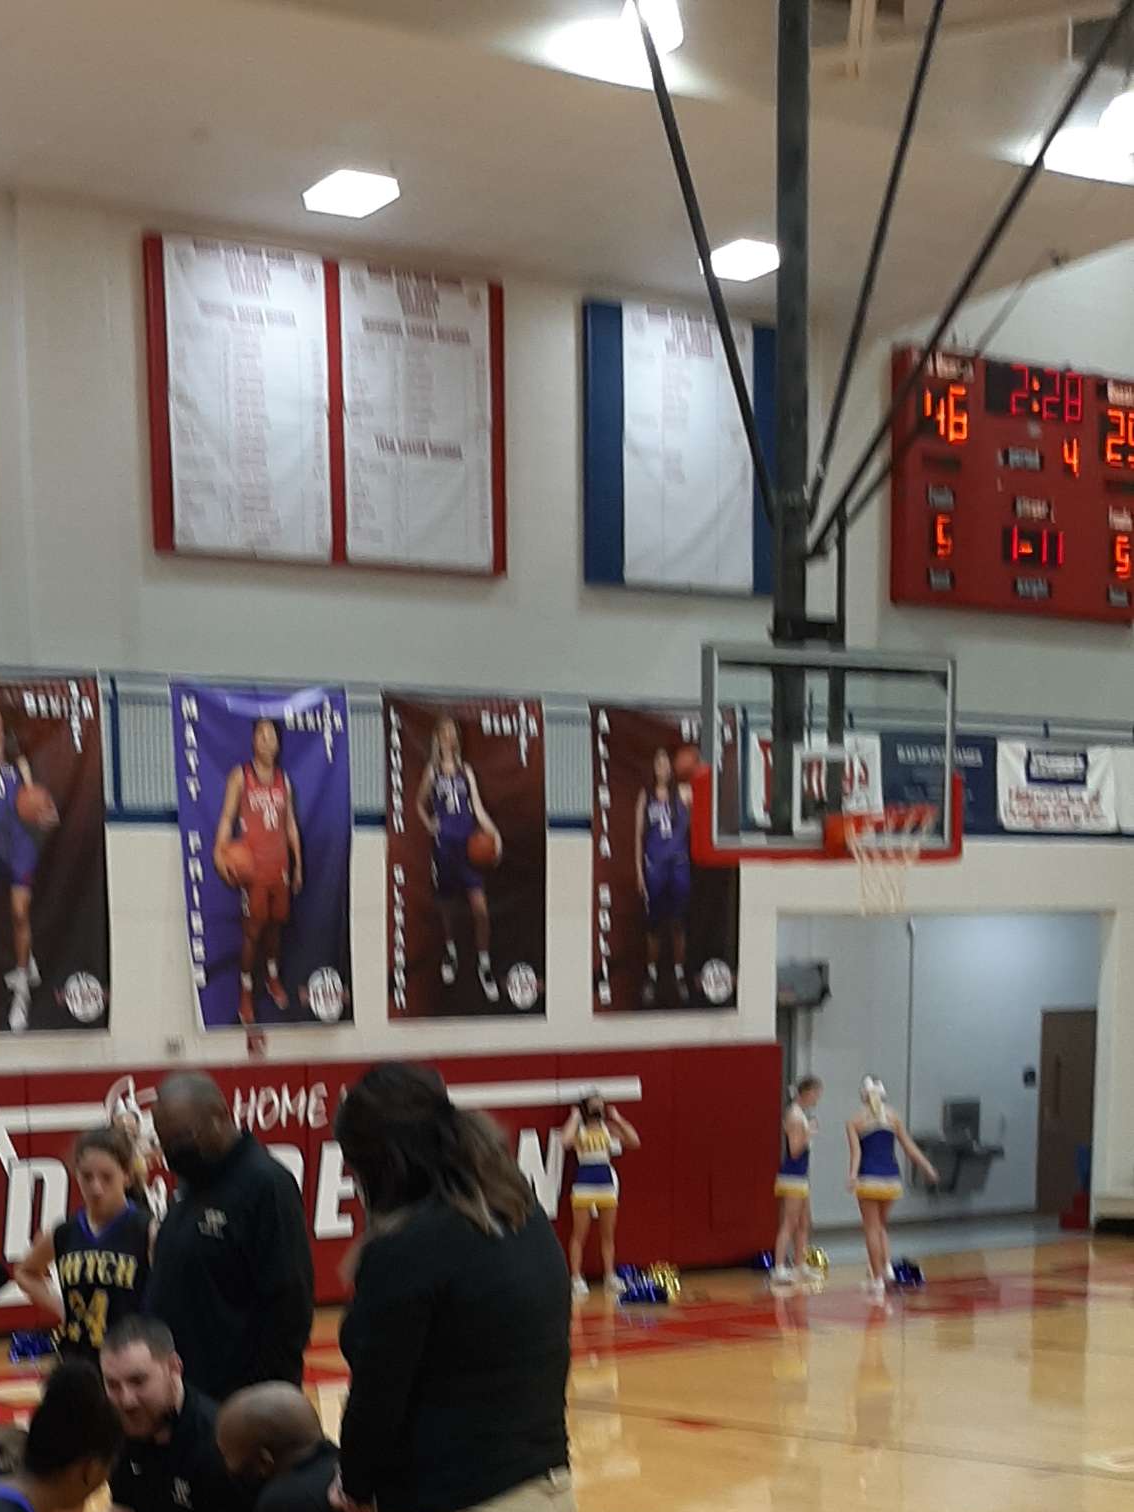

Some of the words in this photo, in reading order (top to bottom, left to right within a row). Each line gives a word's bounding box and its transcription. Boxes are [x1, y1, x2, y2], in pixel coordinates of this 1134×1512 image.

[1010, 363, 1083, 423] 2:28
[1063, 438, 1080, 478] 4
[233, 1082, 329, 1132] HOME
